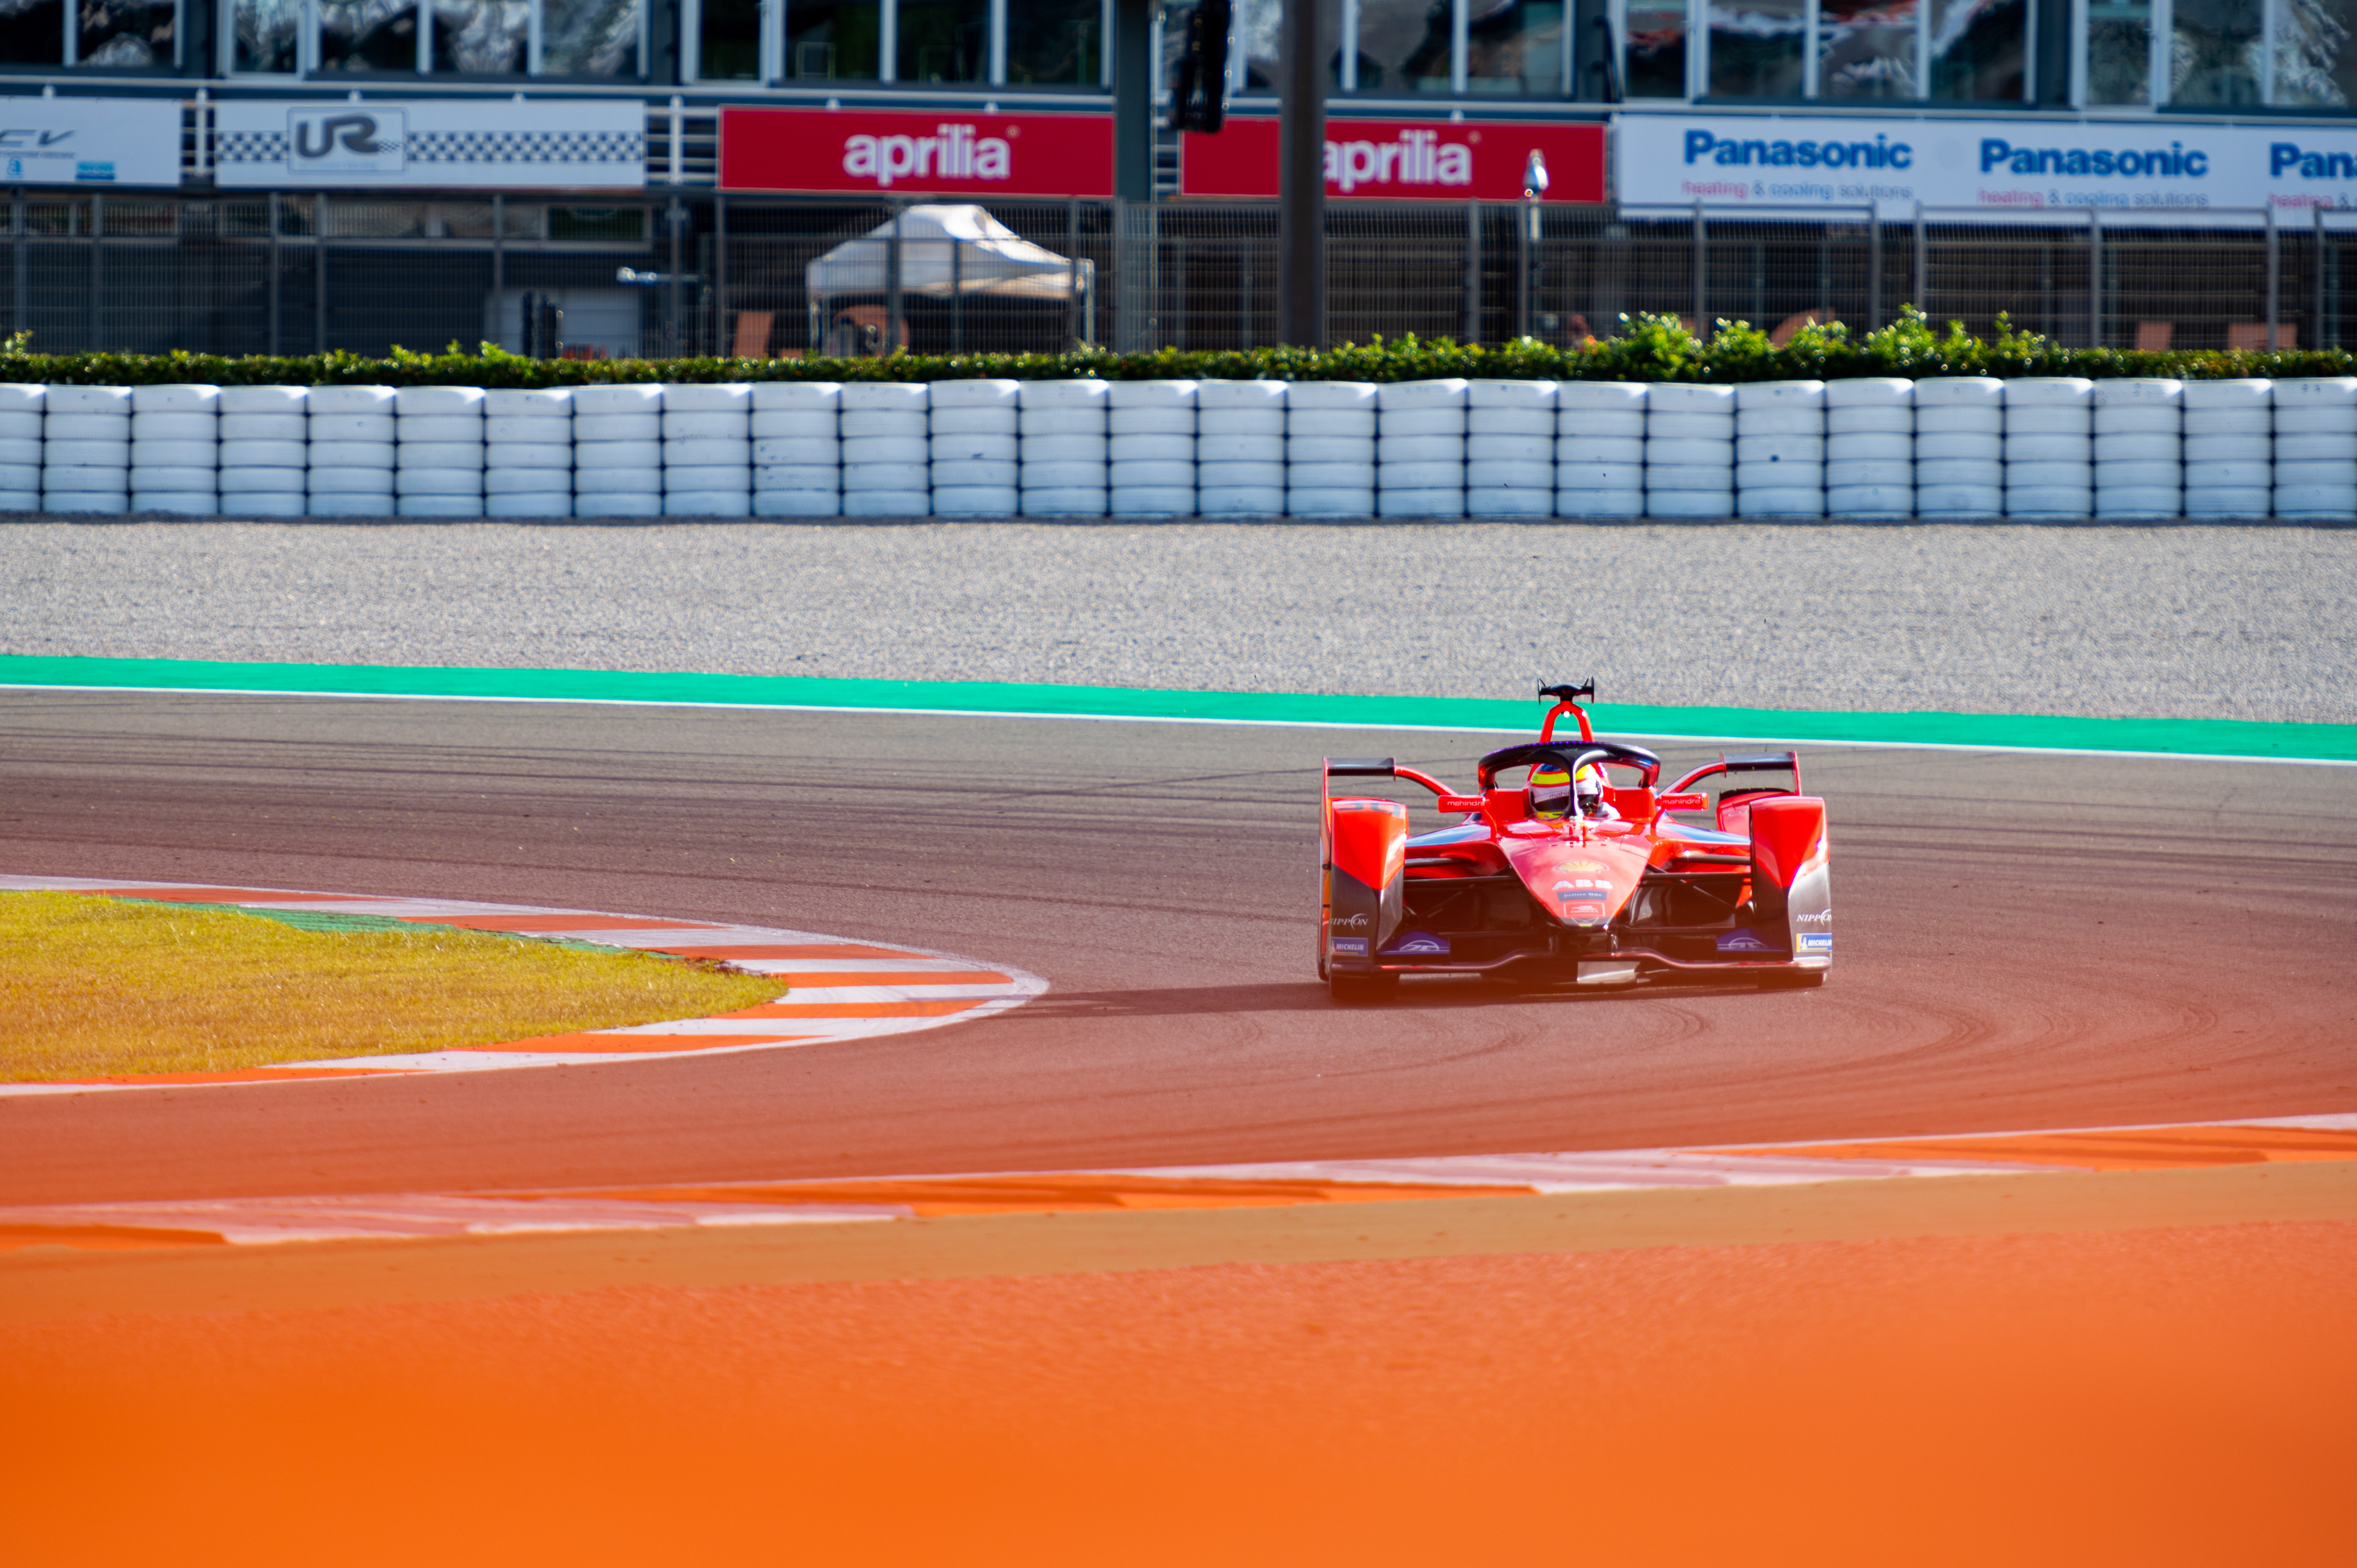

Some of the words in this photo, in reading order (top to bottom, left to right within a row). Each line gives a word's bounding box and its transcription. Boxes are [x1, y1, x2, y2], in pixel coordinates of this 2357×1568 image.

[842, 123, 1011, 187] aprilia
[1685, 130, 1912, 168] Panasonic
[1982, 139, 2208, 176] Panasonic
[2270, 142, 2357, 178] Pan
[1681, 179, 1749, 198] heating
[1753, 180, 1766, 197] &
[1768, 181, 1834, 199] cooling
[1838, 182, 1913, 198] solutions
[1978, 187, 2044, 209] heating
[2047, 189, 2061, 205] &
[2064, 190, 2130, 207] cooling
[2134, 191, 2209, 207] solutions
[2268, 192, 2333, 211] heating
[1550, 790, 1585, 799] mahira
[1552, 880, 1613, 890] ABB
